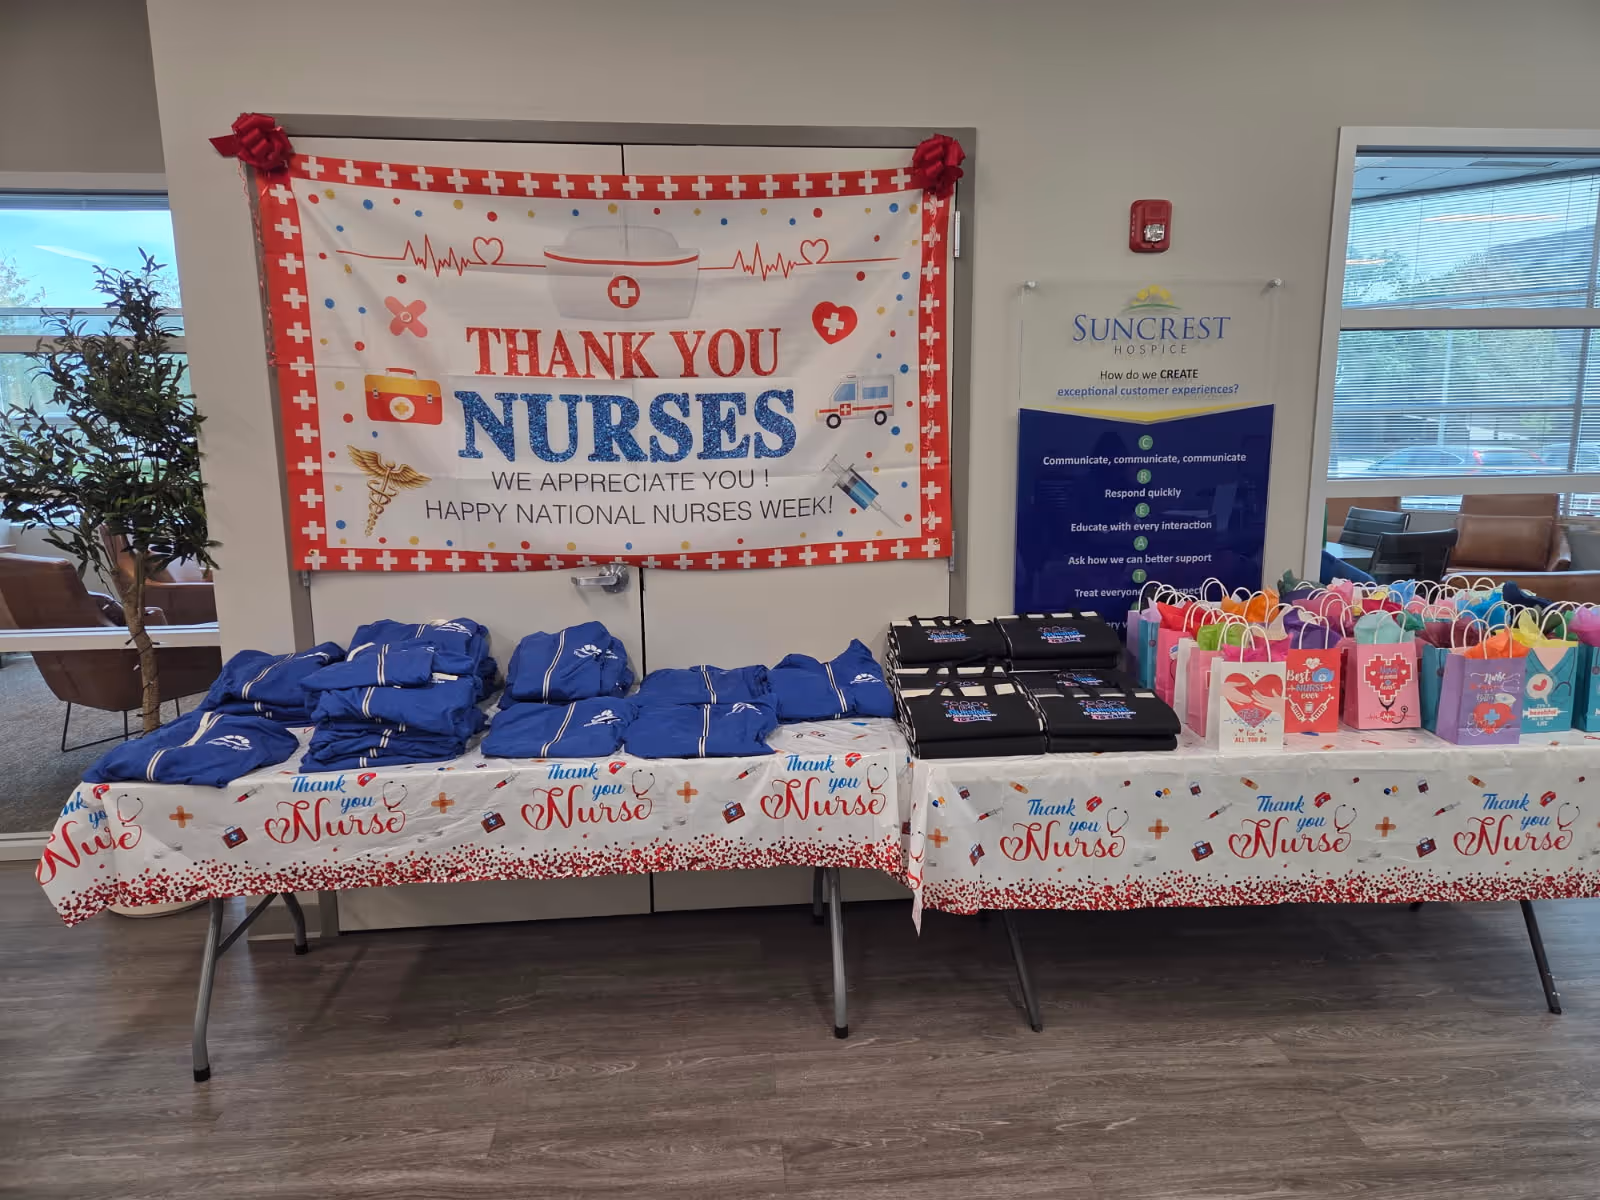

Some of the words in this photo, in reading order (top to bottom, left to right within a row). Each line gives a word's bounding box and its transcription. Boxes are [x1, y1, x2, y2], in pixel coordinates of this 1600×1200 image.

[1072, 314, 1231, 342] SUNCREST
[466, 327, 659, 380] THANK
[669, 328, 781, 378] YOU
[1114, 344, 1187, 355] HOSPICE
[1100, 370, 1122, 380] How
[1126, 369, 1139, 380] do
[1142, 371, 1157, 380] we
[1160, 368, 1199, 379] CREATE
[1057, 386, 1118, 398] exceptional
[1120, 387, 1169, 396] customer
[1171, 384, 1239, 397] experiences?
[454, 389, 797, 463] NURSES
[1142, 437, 1149, 448] C
[1043, 456, 1111, 466] Communicate,
[1114, 454, 1180, 464] communicate,
[1183, 453, 1246, 463] communicate
[491, 471, 532, 491] WE
[540, 472, 695, 493] APPRECIATE
[702, 469, 754, 490] YOU
[1140, 471, 1147, 481] R
[1105, 488, 1145, 499] Respond
[1147, 488, 1181, 499] quickly
[425, 500, 507, 523] HAPPY
[516, 504, 646, 525] NATIONAL
[653, 500, 752, 524] NURSES
[759, 495, 833, 519] WEEK!
[1071, 523, 1108, 532] Educate
[1110, 522, 1131, 531] with
[1133, 523, 1159, 533] every
[1161, 521, 1212, 530] interaction
[1068, 556, 1085, 565] Ask
[1087, 555, 1108, 565] how
[1126, 556, 1142, 564] can
[1145, 554, 1173, 563] better
[1175, 554, 1212, 565] support
[1075, 588, 1098, 597] Treat
[1175, 586, 1201, 596] espect
[1286, 668, 1311, 684] Best
[547, 763, 599, 780] Thank
[785, 755, 835, 773] Thank
[291, 775, 347, 793] Thank
[592, 783, 625, 801] you
[829, 776, 861, 793] you
[340, 795, 376, 815] you
[521, 784, 653, 831] Nurse
[760, 777, 887, 820] Nurse
[1027, 798, 1076, 816] Thank
[1256, 795, 1305, 813] Thank
[1482, 792, 1530, 811] Thank
[88, 810, 108, 830] yo
[264, 798, 405, 843] Nurse
[1068, 820, 1101, 836] you
[1297, 816, 1328, 832] you
[1520, 815, 1551, 831] you
[1000, 820, 1125, 861] Nurse
[1228, 817, 1352, 859] Nurse
[1453, 814, 1573, 856] Nurse
